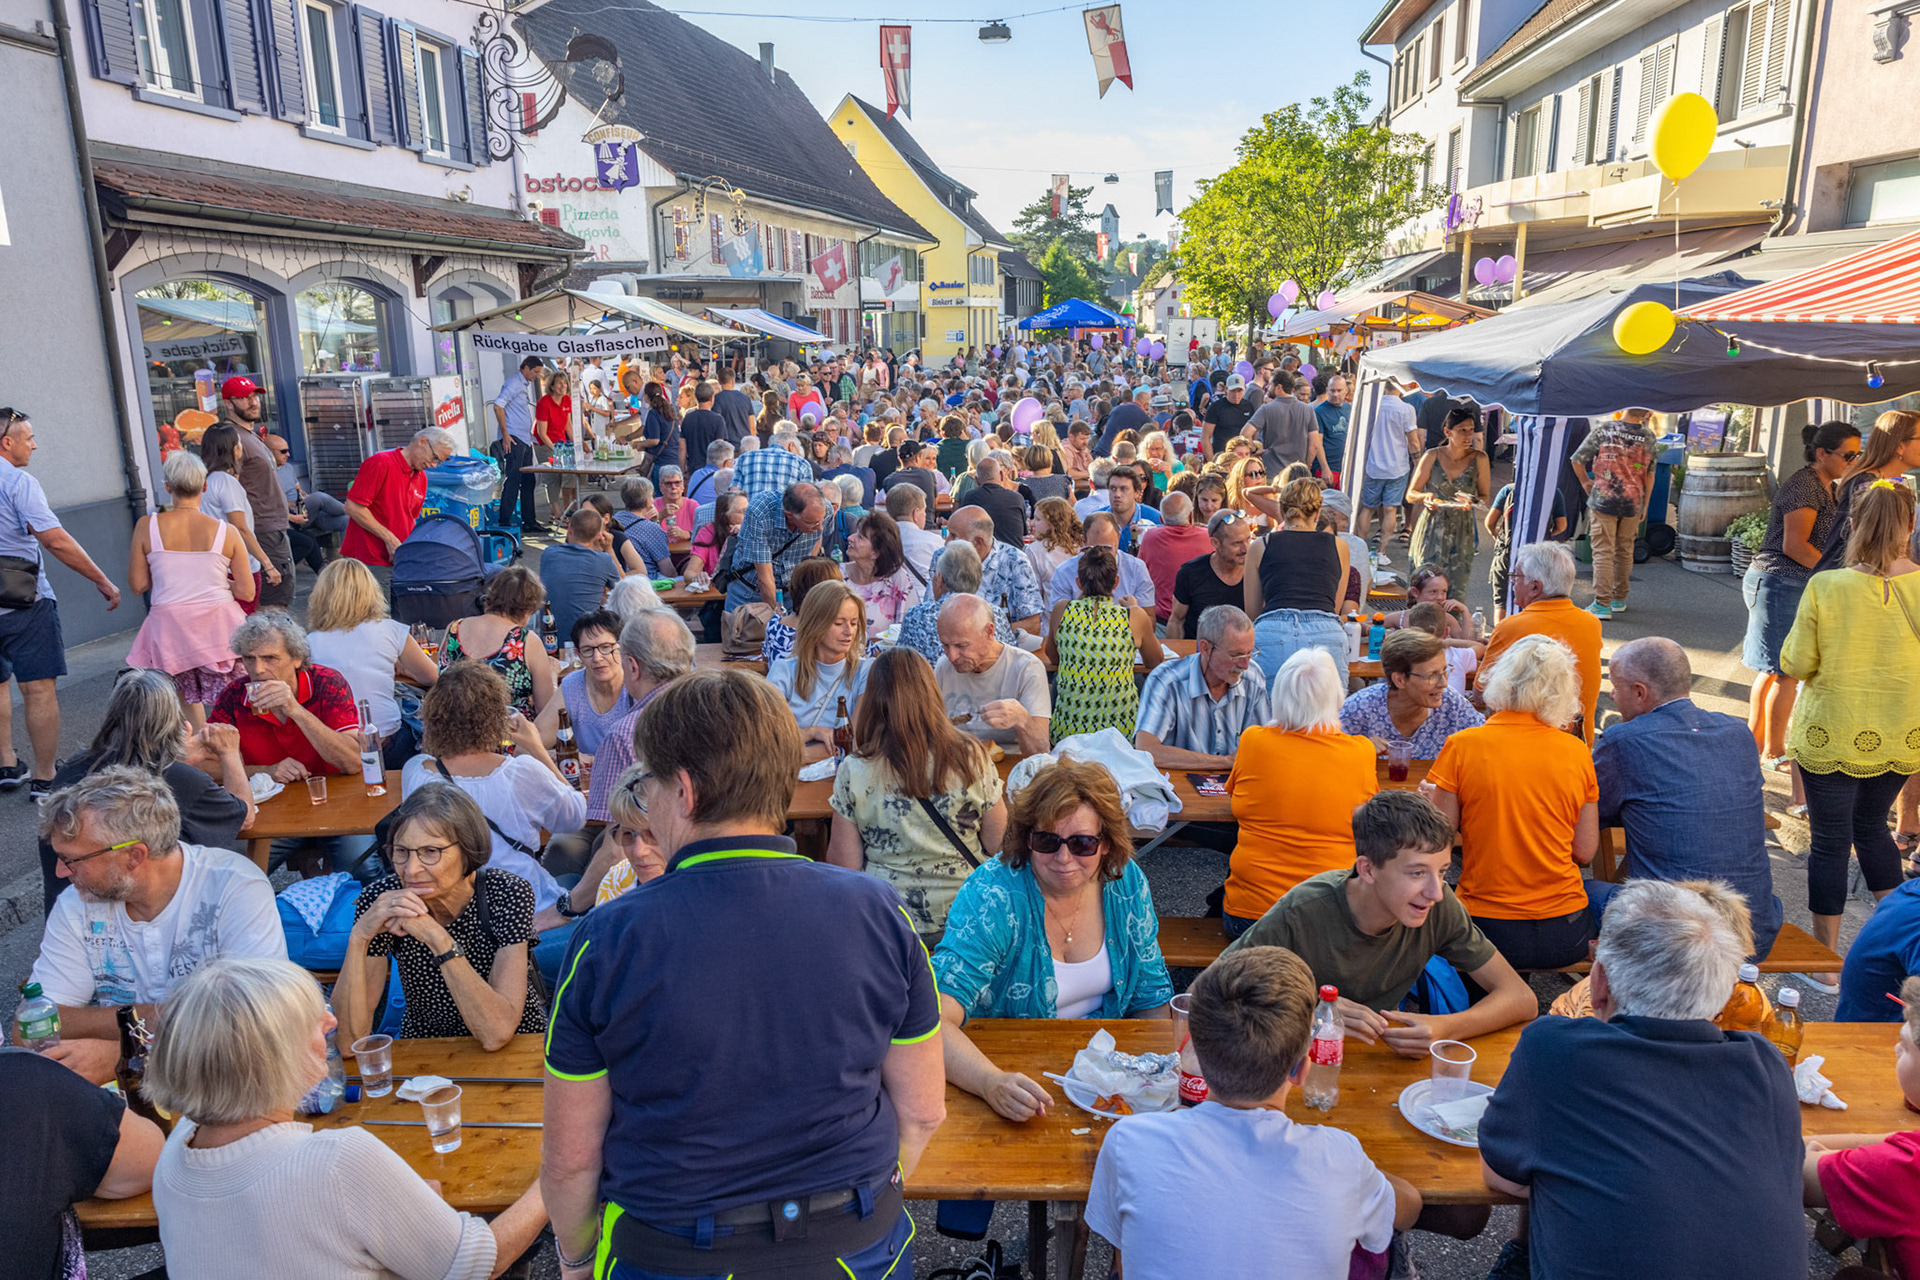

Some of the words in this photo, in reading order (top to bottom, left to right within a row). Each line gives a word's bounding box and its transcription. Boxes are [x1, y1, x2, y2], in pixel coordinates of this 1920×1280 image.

[587, 127, 641, 144] CONFISEUR
[524, 173, 617, 193] bstoc
[562, 203, 619, 221] Pizzeria
[566, 223, 621, 241] Argovia
[931, 298, 953, 306] Binkert
[473, 334, 548, 353] Rückgabe
[557, 336, 665, 354] Glasflaschen
[438, 402, 460, 425] rivella
